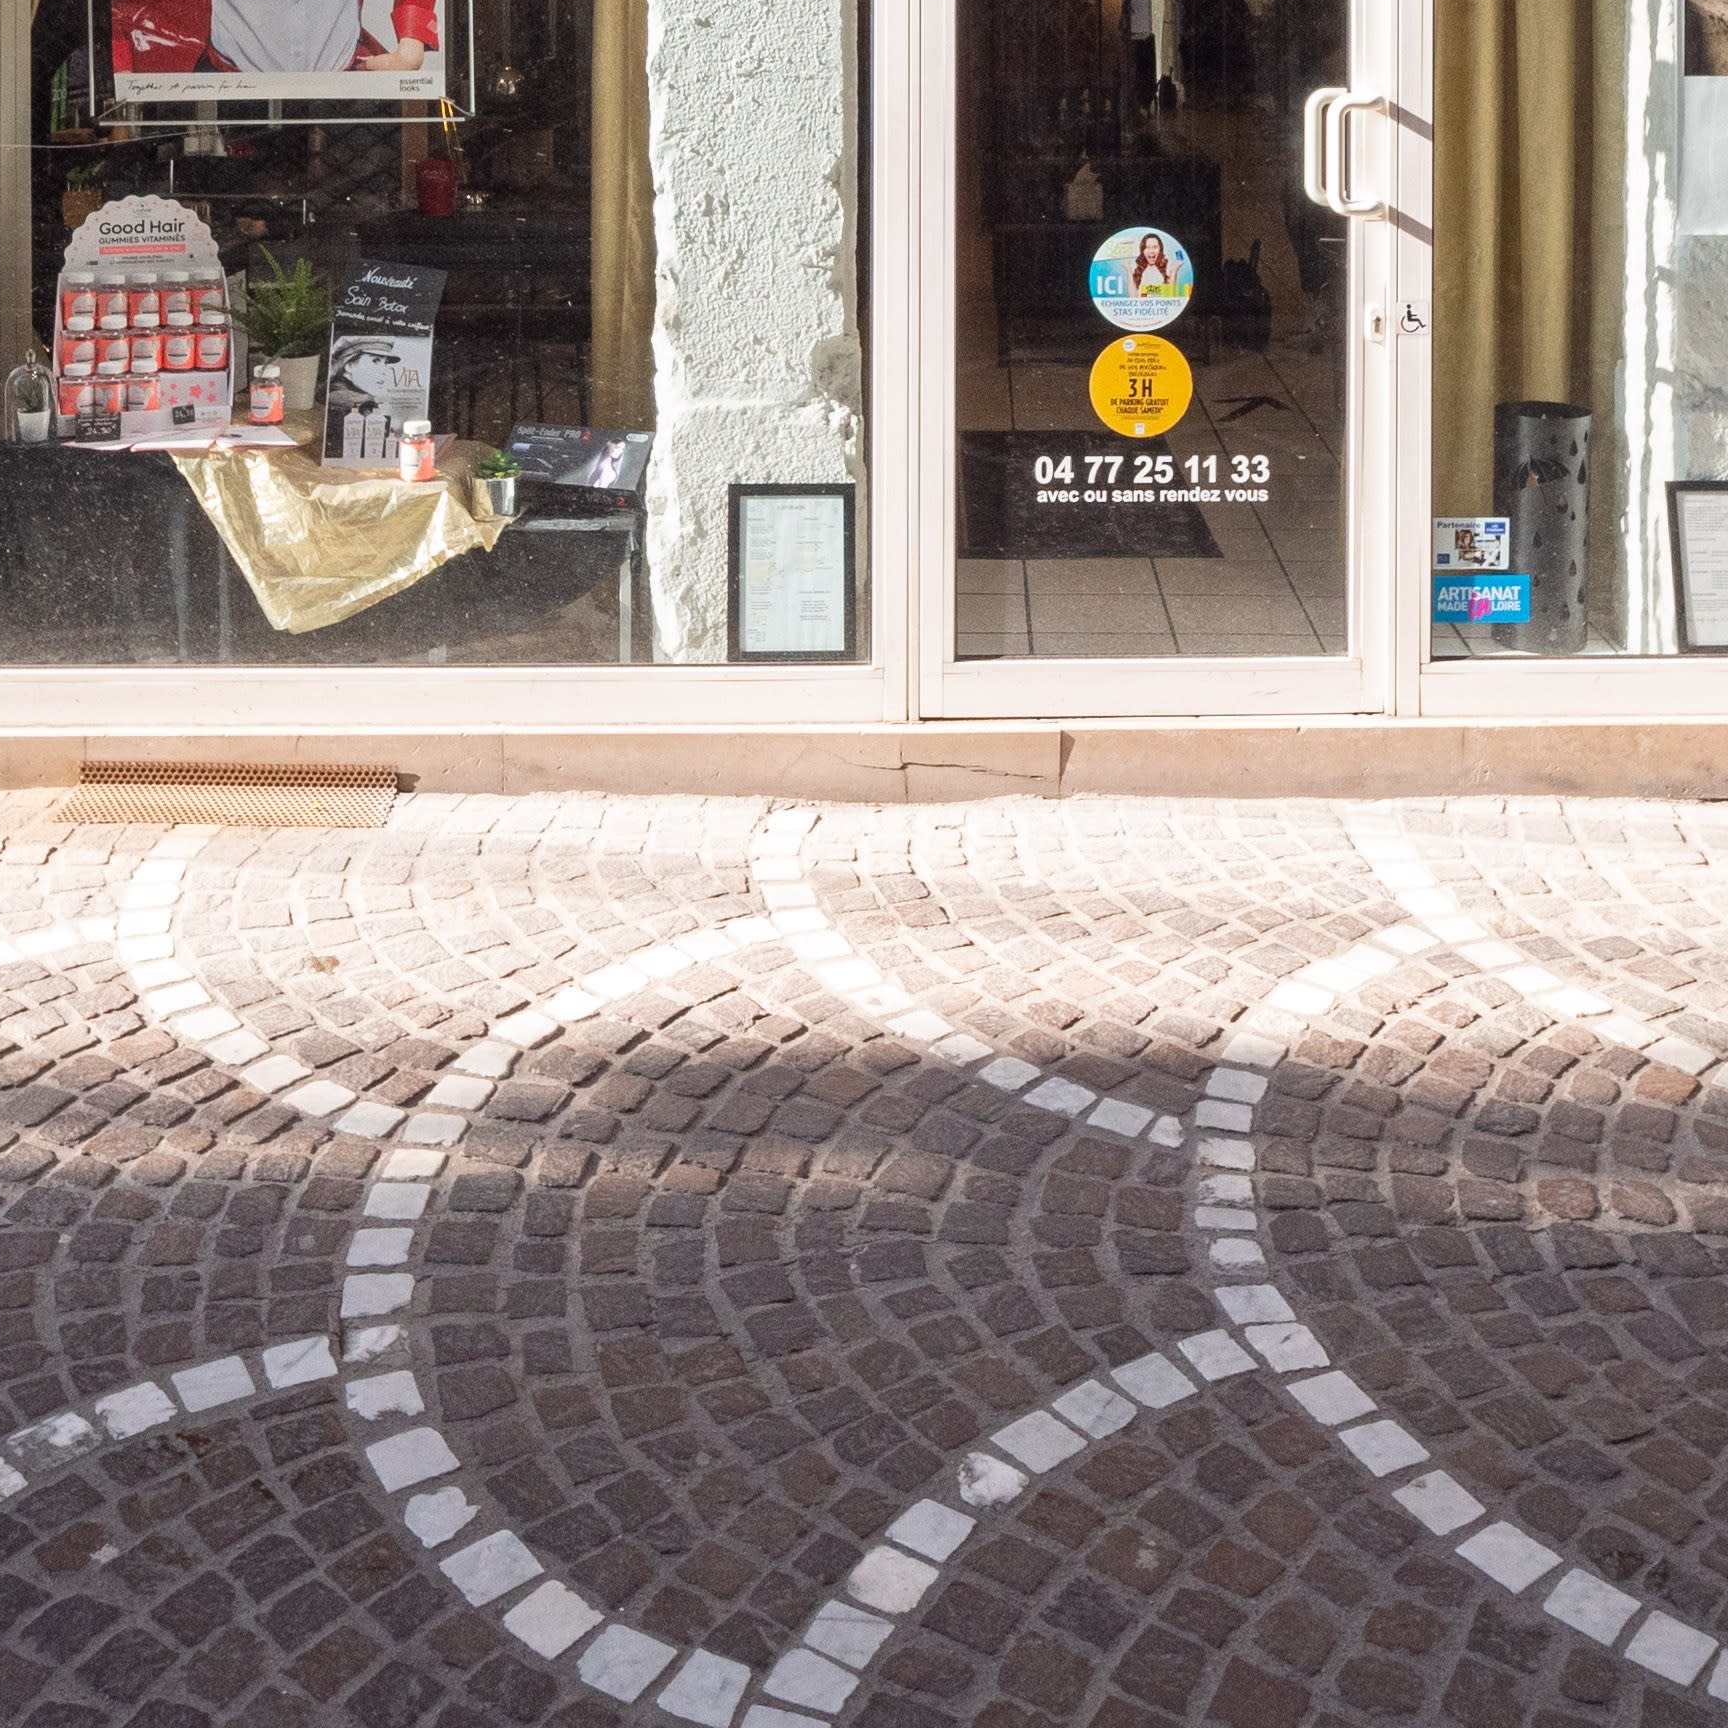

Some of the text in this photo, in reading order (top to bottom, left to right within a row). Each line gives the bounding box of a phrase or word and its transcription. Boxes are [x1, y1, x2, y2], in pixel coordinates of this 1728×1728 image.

[99, 217, 185, 235] Good Hair
[99, 235, 140, 245] GUMMIES
[1096, 275, 1124, 295] ICI
[344, 285, 372, 306] Soin
[1128, 378, 1153, 398] 3 H
[1034, 454, 1270, 484] 04 77 25 11 33
[1036, 487, 1270, 503] avec ou sans rendez vous
[1437, 586, 1521, 601] ARTISANAT
[1437, 600, 1469, 612] MADE
[1492, 600, 1521, 612] LOIRE
